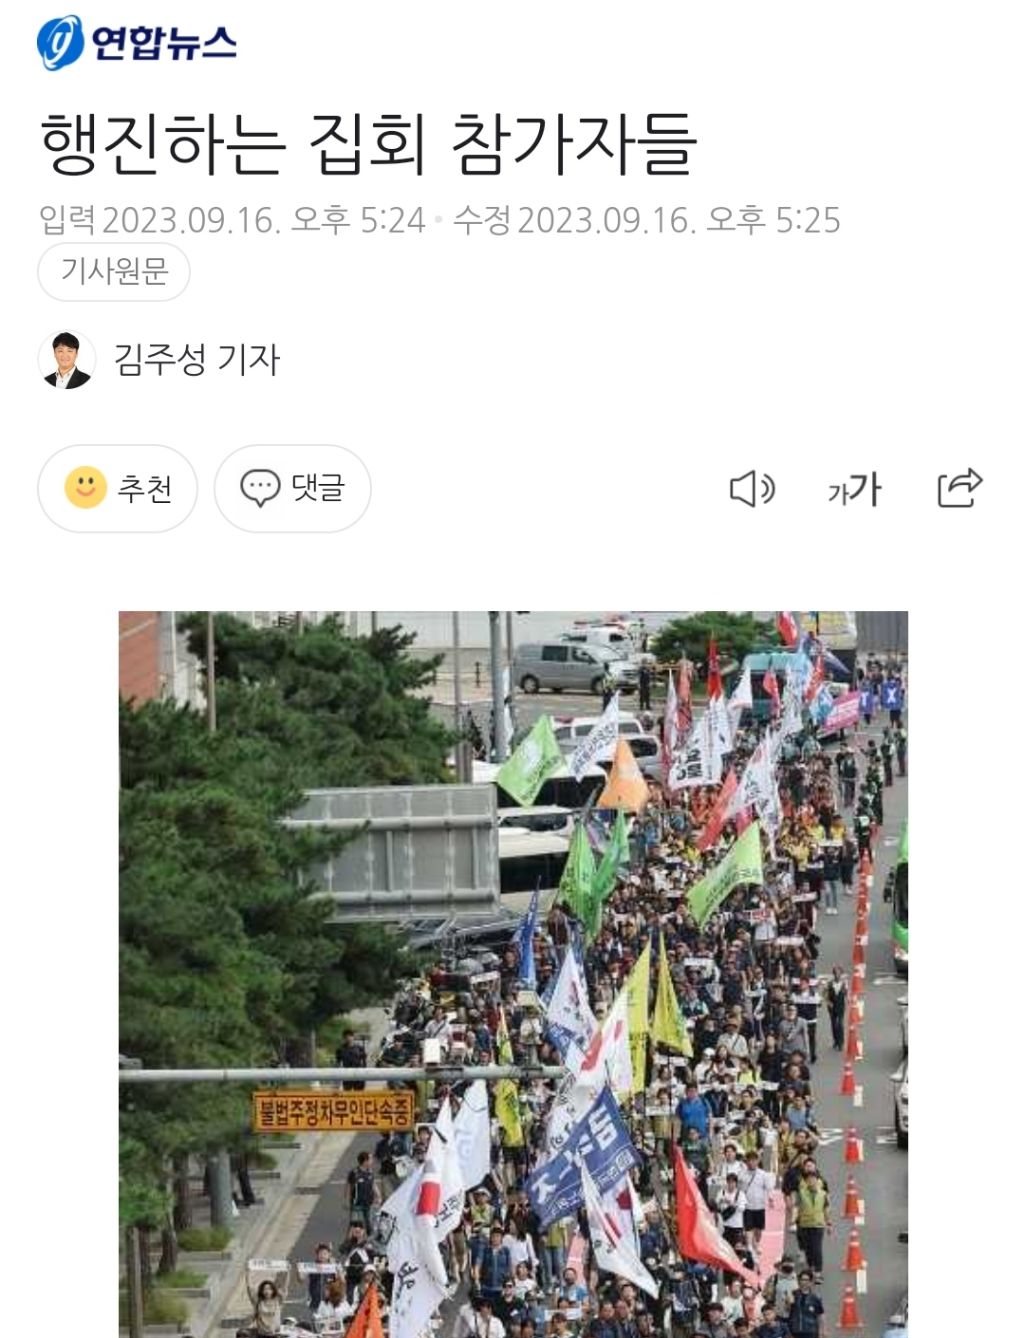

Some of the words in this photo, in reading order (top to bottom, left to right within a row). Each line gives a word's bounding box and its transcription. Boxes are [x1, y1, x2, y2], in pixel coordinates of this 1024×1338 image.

[92, 26, 237, 61] 연합뉴스
[41, 113, 286, 176] 행진하는
[310, 113, 422, 176] 집회
[453, 113, 697, 176] 참가자들
[40, 205, 94, 235] 입력
[103, 206, 281, 234] 2023.09.16.
[291, 205, 350, 235] 오후
[362, 207, 425, 233] 5:24
[454, 205, 509, 236] 수정
[519, 206, 696, 234] 2023.09.16.
[707, 205, 766, 235] 오후
[778, 207, 840, 233] 5:25
[62, 257, 168, 285] 기사원문
[115, 343, 204, 376] 김주성
[219, 343, 280, 376] 기자
[118, 475, 171, 503] 추천
[293, 473, 345, 501] 댓글
[261, 1100, 409, 1126] 불법주정차무인단속중
